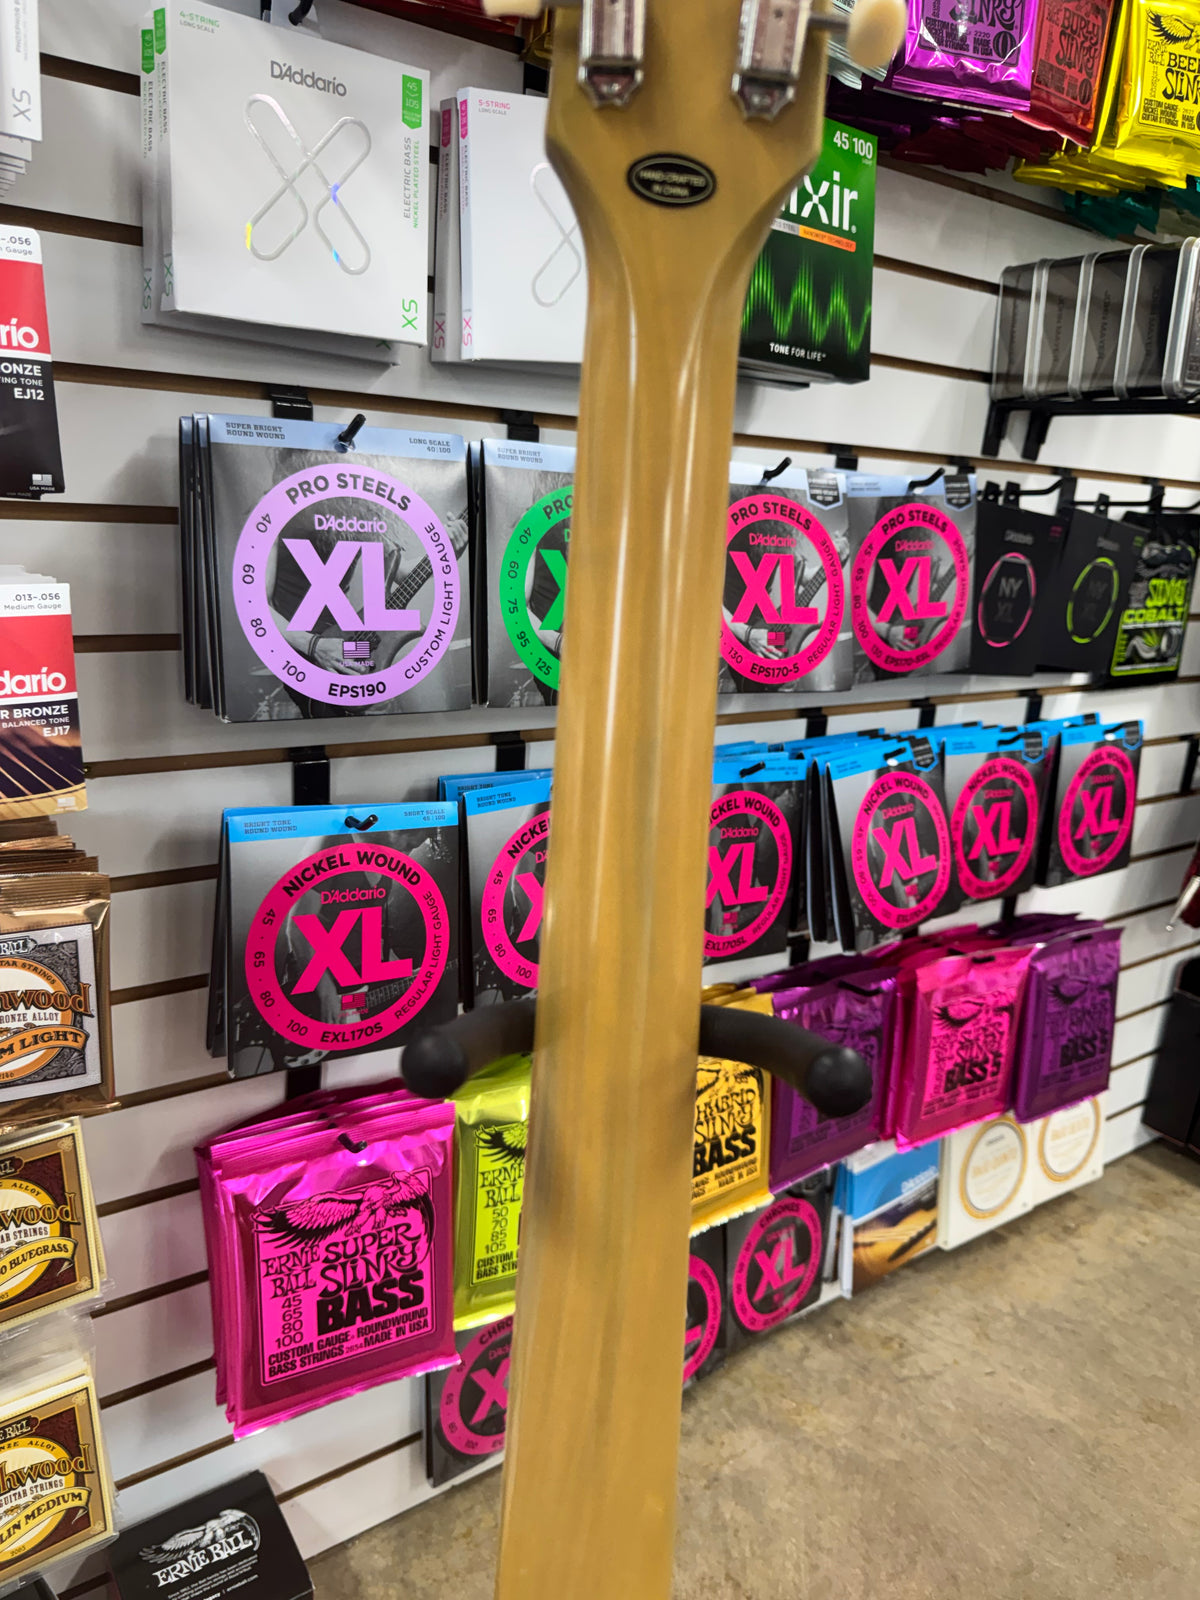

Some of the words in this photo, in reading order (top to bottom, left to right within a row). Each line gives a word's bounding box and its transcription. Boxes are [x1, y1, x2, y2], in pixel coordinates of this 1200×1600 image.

[404, 136, 412, 167] BASS
[833, 130, 849, 150] 45
[852, 136, 873, 160] 100
[403, 169, 411, 219] ELECTRIC
[401, 298, 418, 331] XS
[769, 342, 790, 355] TONE
[790, 347, 806, 358] FOR
[20, 378, 44, 387] TONE
[14, 387, 45, 401] EJ12
[226, 422, 252, 433] SUPER
[253, 423, 284, 434] BRIGHT
[226, 430, 254, 439] ROUND
[254, 431, 286, 440] WOUND
[409, 438, 426, 446] LONG
[427, 440, 451, 448] SCALE
[285, 475, 330, 505] PRO
[336, 472, 412, 512] STEELS
[255, 512, 272, 534] 40
[731, 503, 759, 525] PRO
[763, 502, 812, 531] STEELS
[882, 514, 906, 535] PRO
[908, 509, 948, 533] STEELS
[519, 527, 533, 545] 40
[424, 522, 452, 575] GAUGE
[820, 539, 839, 577] GAUGE
[242, 563, 255, 585] 60
[507, 560, 520, 580] 60
[281, 538, 421, 632] XL
[729, 551, 819, 625] XL
[875, 556, 948, 624] XL
[37, 602, 62, 611] Gauge
[440, 581, 454, 625] LIGHT
[508, 597, 519, 615] 75
[832, 583, 841, 618] LIGHT
[250, 616, 267, 638] 80
[516, 630, 530, 648] 95
[807, 621, 837, 665] REGULAR
[404, 629, 446, 680] CUSTOM
[728, 646, 743, 665] 130
[281, 659, 307, 683] 100
[534, 656, 553, 676] 125
[328, 681, 387, 698] EPS190
[2, 718, 47, 729] BALANCED
[49, 716, 70, 725] TONE
[13, 704, 69, 720] BRONZE
[42, 725, 70, 738] EJ17
[864, 782, 893, 815] NICKEL
[894, 777, 929, 800] WOUND
[744, 797, 780, 828] WOUND
[1074, 786, 1121, 840] XL
[968, 801, 1022, 861] XL
[872, 817, 937, 889] XL
[282, 853, 351, 898] NICKEL
[356, 851, 422, 886] WOUND
[493, 870, 504, 886] 45
[705, 842, 769, 909] XL
[262, 908, 276, 927] 45
[423, 890, 443, 930] GAUGE
[487, 908, 497, 923] 65
[253, 951, 265, 968] 65
[290, 906, 413, 995] XL
[431, 933, 443, 969] LIGHT
[494, 943, 506, 958] 80
[20, 960, 57, 985] STRINGS
[515, 964, 532, 979] 100
[259, 990, 276, 1008] 80
[394, 970, 435, 1020] REGULAR
[32, 1012, 60, 1022] ALLOY
[286, 1018, 309, 1038] 100
[20, 1030, 82, 1050] LIGHT
[320, 1022, 384, 1044] EXL170S
[696, 1088, 756, 1121] HYBRID
[692, 1126, 756, 1178] BASS
[12, 1182, 42, 1197] ALLOY
[485, 1182, 521, 1209] BALL
[492, 1206, 509, 1218] 50
[13, 1227, 49, 1240] STRINGS
[491, 1217, 508, 1230] 70
[321, 1222, 422, 1263] SUPER
[491, 1229, 507, 1242] 85
[9, 1242, 70, 1271] BLUEGRASS
[485, 1241, 507, 1254] 105
[476, 1264, 500, 1280] BASS
[477, 1253, 514, 1269] CUSTOM
[753, 1237, 806, 1302] XL
[270, 1268, 317, 1299] BALL
[281, 1294, 303, 1309] 45
[316, 1270, 424, 1336] BASS
[281, 1308, 303, 1322] 65
[268, 1342, 314, 1366] CUSTOM
[317, 1331, 351, 1350] GAUGE
[357, 1307, 429, 1338] ROUNDWOUND
[281, 1319, 304, 1335] 80
[268, 1361, 297, 1378] BASS
[299, 1345, 345, 1369] STRINGS
[364, 1330, 393, 1348] MADE
[396, 1325, 406, 1338] IN
[408, 1318, 429, 1334] USA
[275, 1331, 304, 1349] 100
[5, 1419, 31, 1440] BALL
[27, 1440, 57, 1452] ALLOY
[29, 1478, 64, 1496] STRINGS
[24, 1492, 83, 1527] MEDIUM
[207, 1530, 253, 1563] BALL
